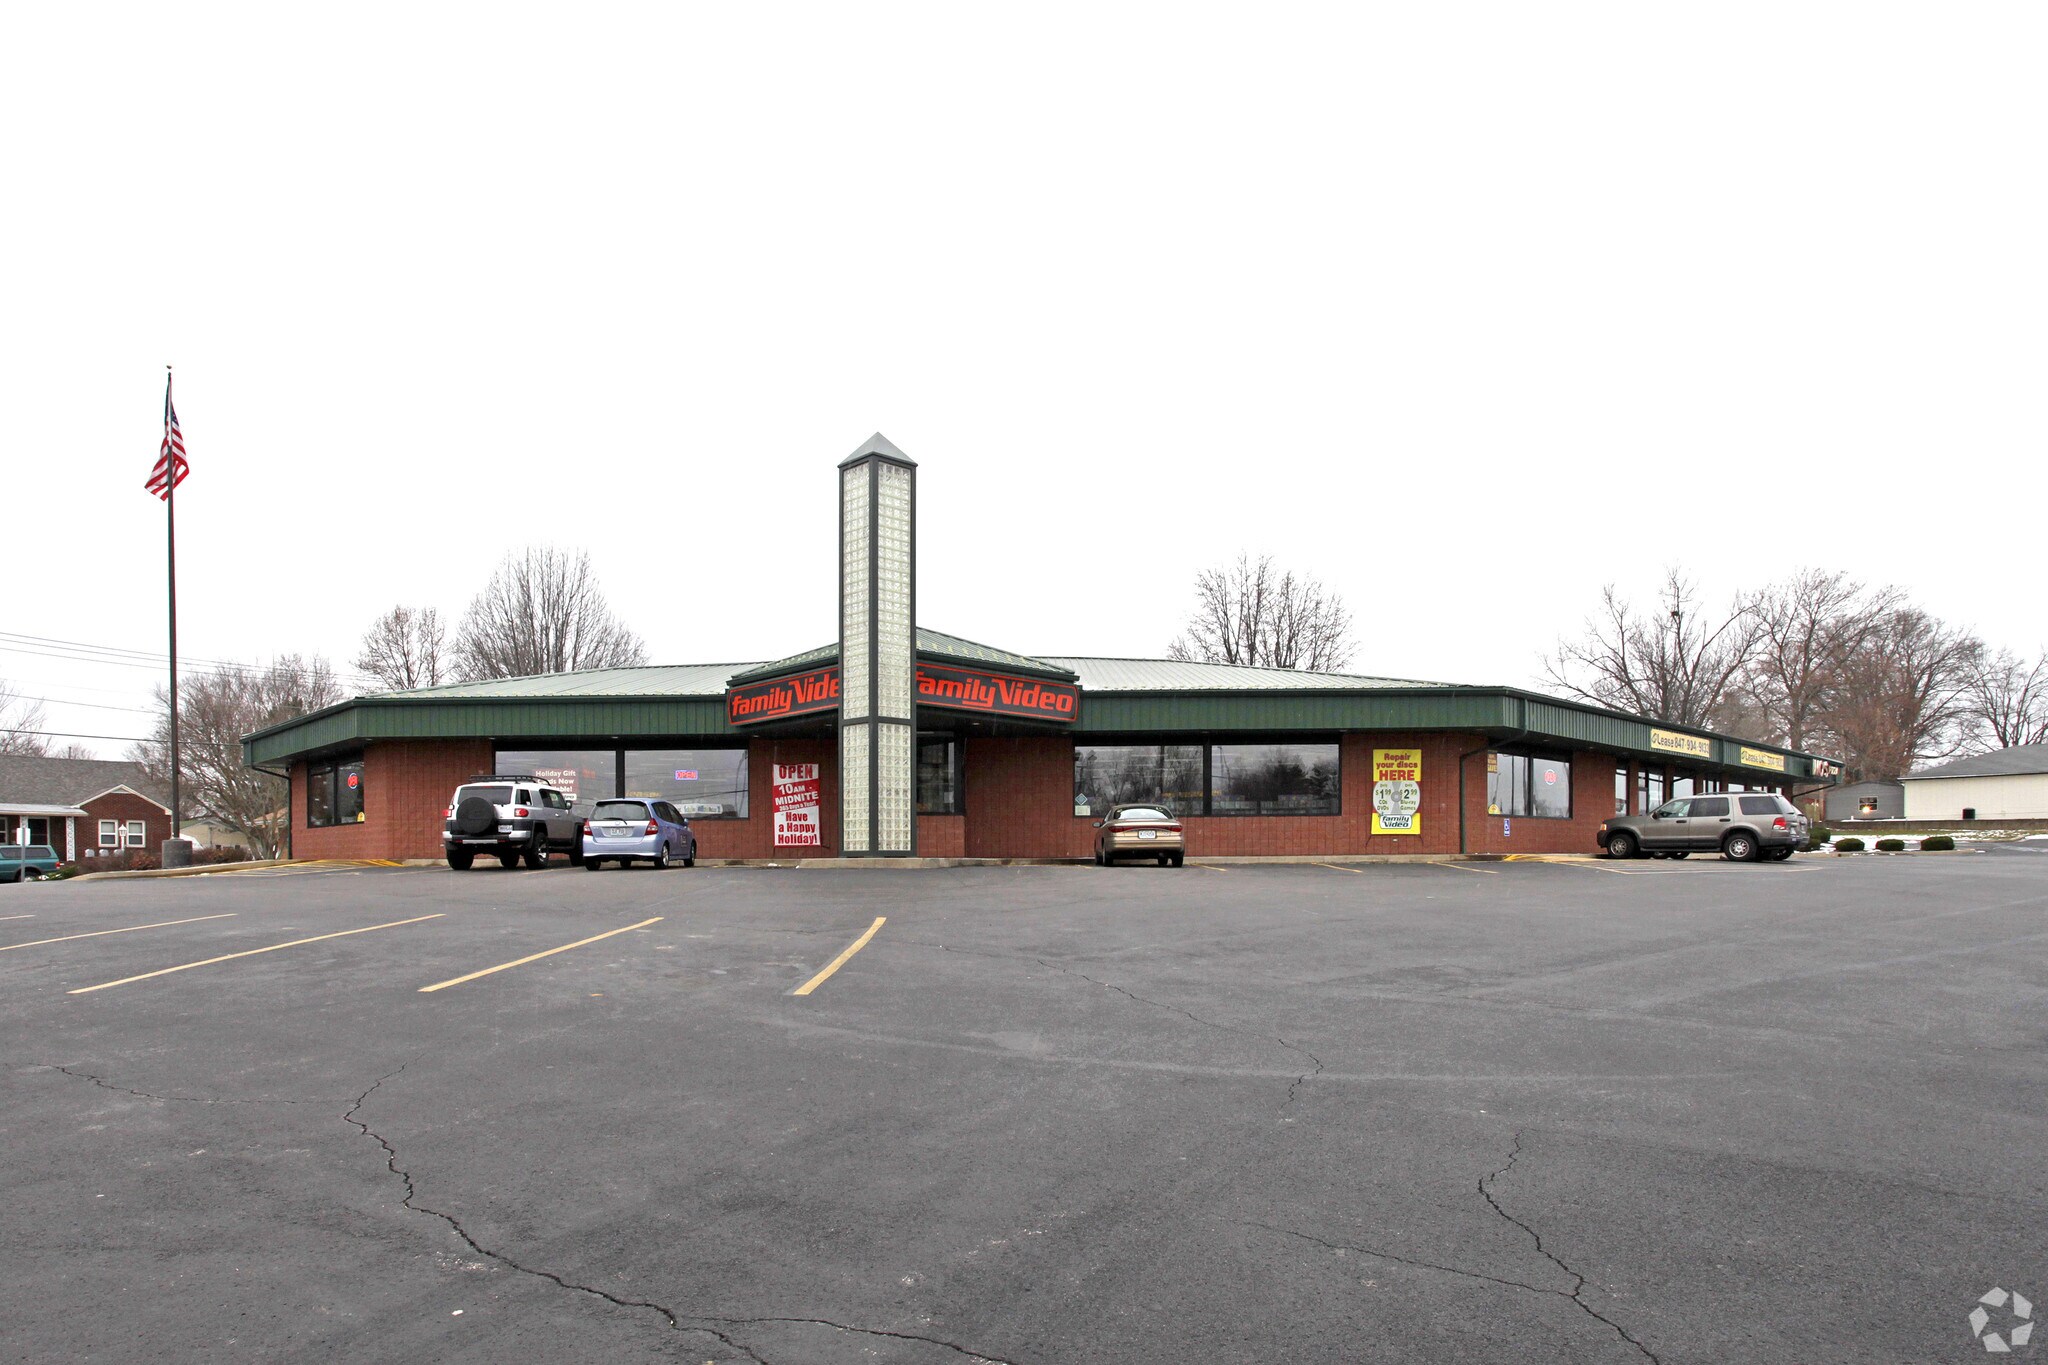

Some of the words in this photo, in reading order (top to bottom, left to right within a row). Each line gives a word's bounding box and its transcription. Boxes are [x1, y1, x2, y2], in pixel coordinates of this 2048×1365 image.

[732, 687, 792, 716] family
[789, 673, 839, 704] Vide
[992, 678, 1073, 712] Video
[1384, 753, 1411, 761] Repair
[779, 764, 813, 779] OPEN
[1379, 769, 1415, 781] HERE
[775, 791, 819, 806] MIDNITE
[785, 812, 808, 821] Have
[778, 824, 784, 832] a
[787, 823, 815, 833] Happy
[778, 834, 817, 844] Holiday!
